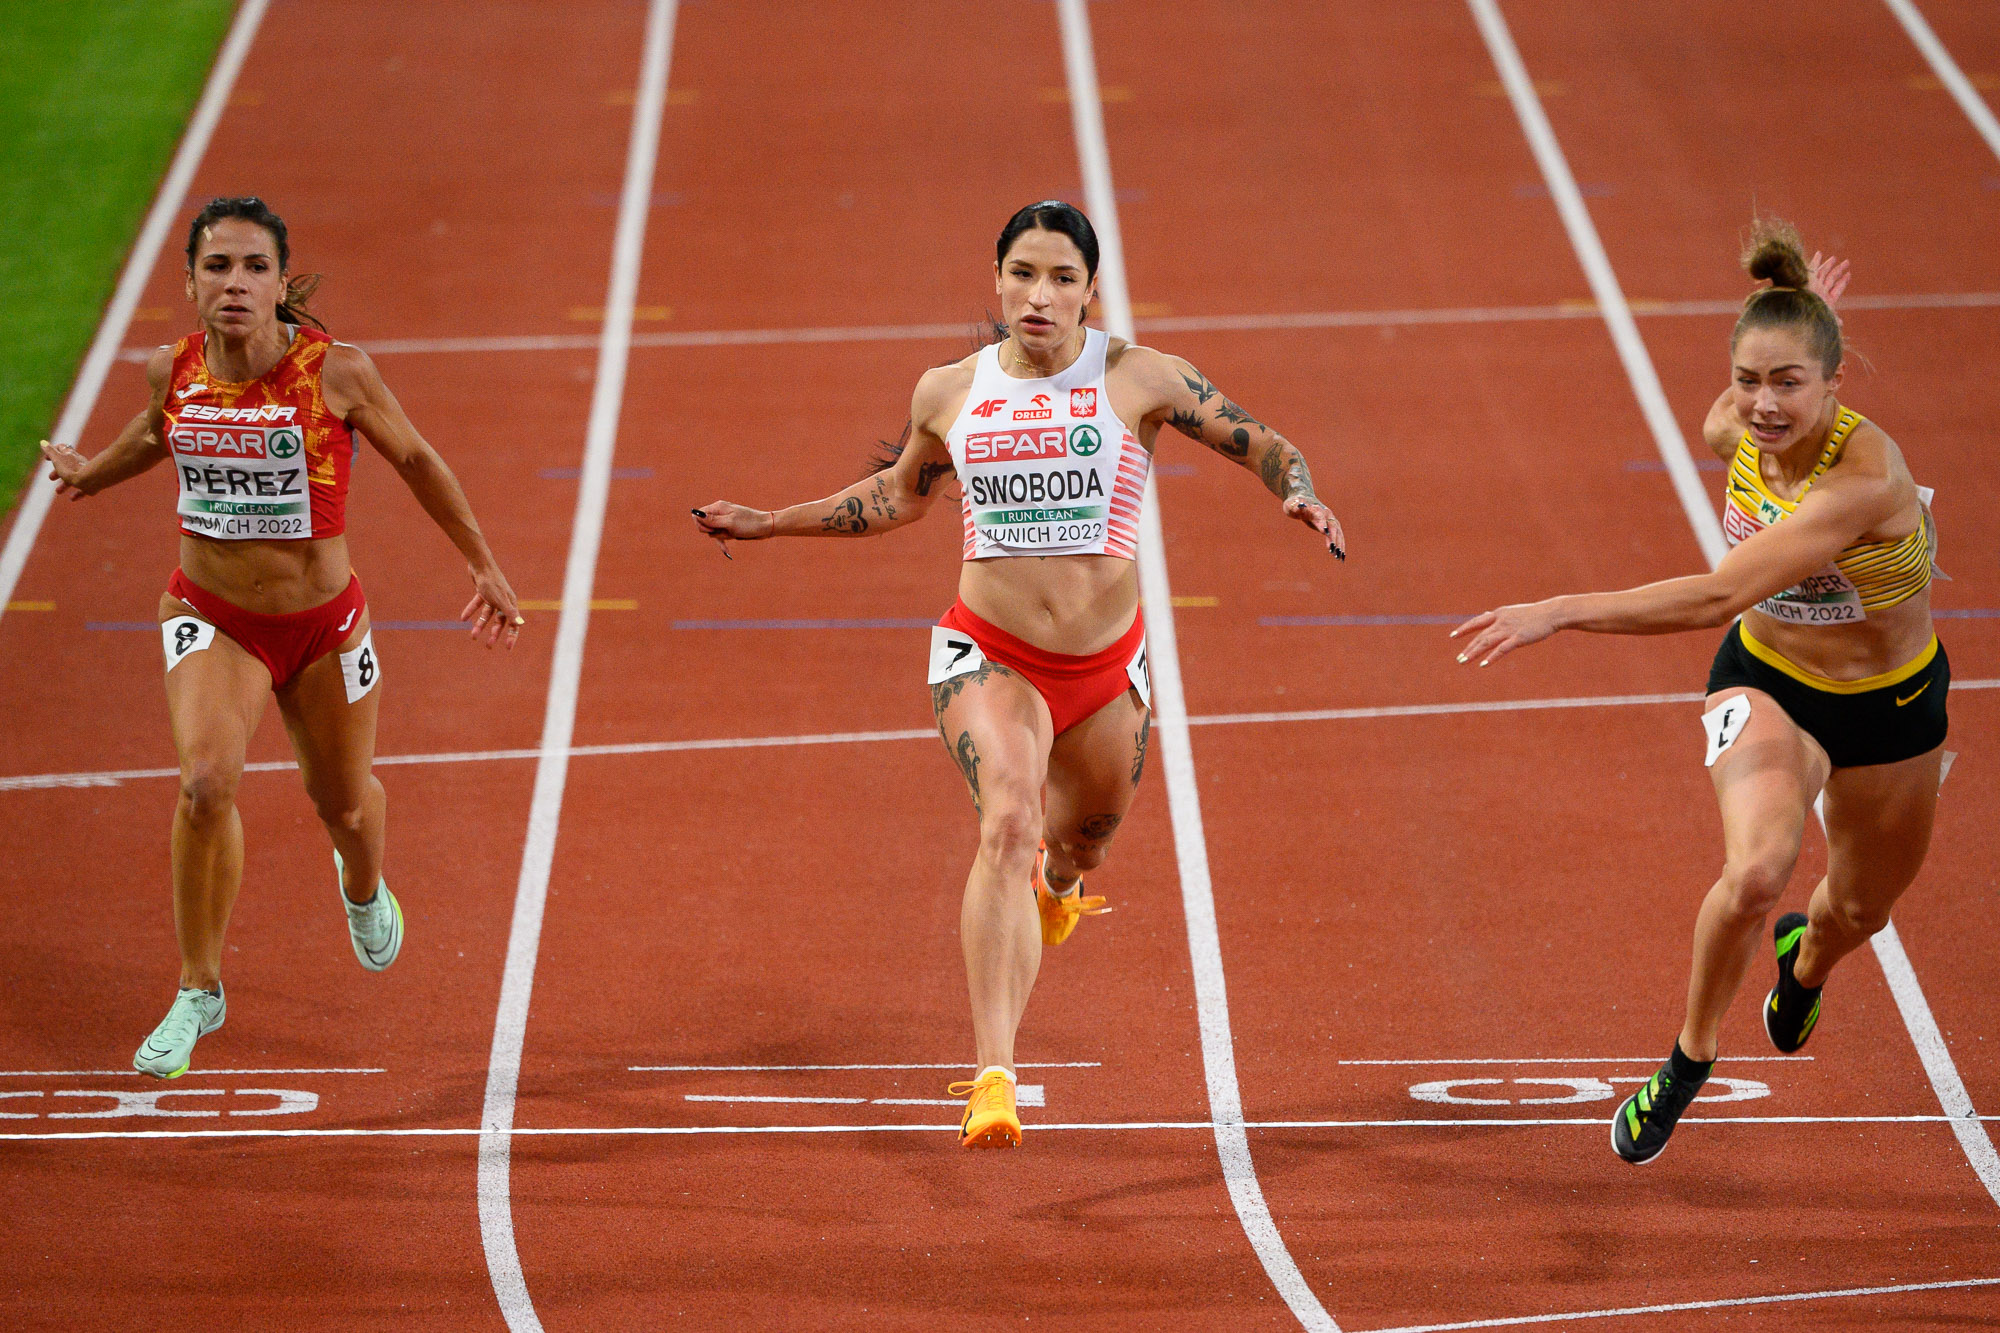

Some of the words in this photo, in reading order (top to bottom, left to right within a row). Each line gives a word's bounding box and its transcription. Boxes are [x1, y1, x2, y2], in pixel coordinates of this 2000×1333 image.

[179, 404, 298, 422] ESPAÑA
[971, 400, 1007, 418] 4F
[1015, 410, 1050, 421] ORLEN
[173, 430, 264, 455] SPAR
[968, 431, 1064, 459] SPAR
[182, 464, 302, 496] PÉREZ
[971, 467, 1105, 506] SWOBODA
[214, 502, 233, 513] RUN
[1001, 512, 1006, 522] I
[1009, 511, 1033, 522] RUN
[258, 518, 303, 534] 2022
[1058, 523, 1102, 541] 2022
[1728, 509, 1757, 540] SP
[1808, 605, 1856, 621] 2022
[174, 622, 200, 656] 8
[358, 647, 374, 687] 8
[945, 639, 974, 674] 7
